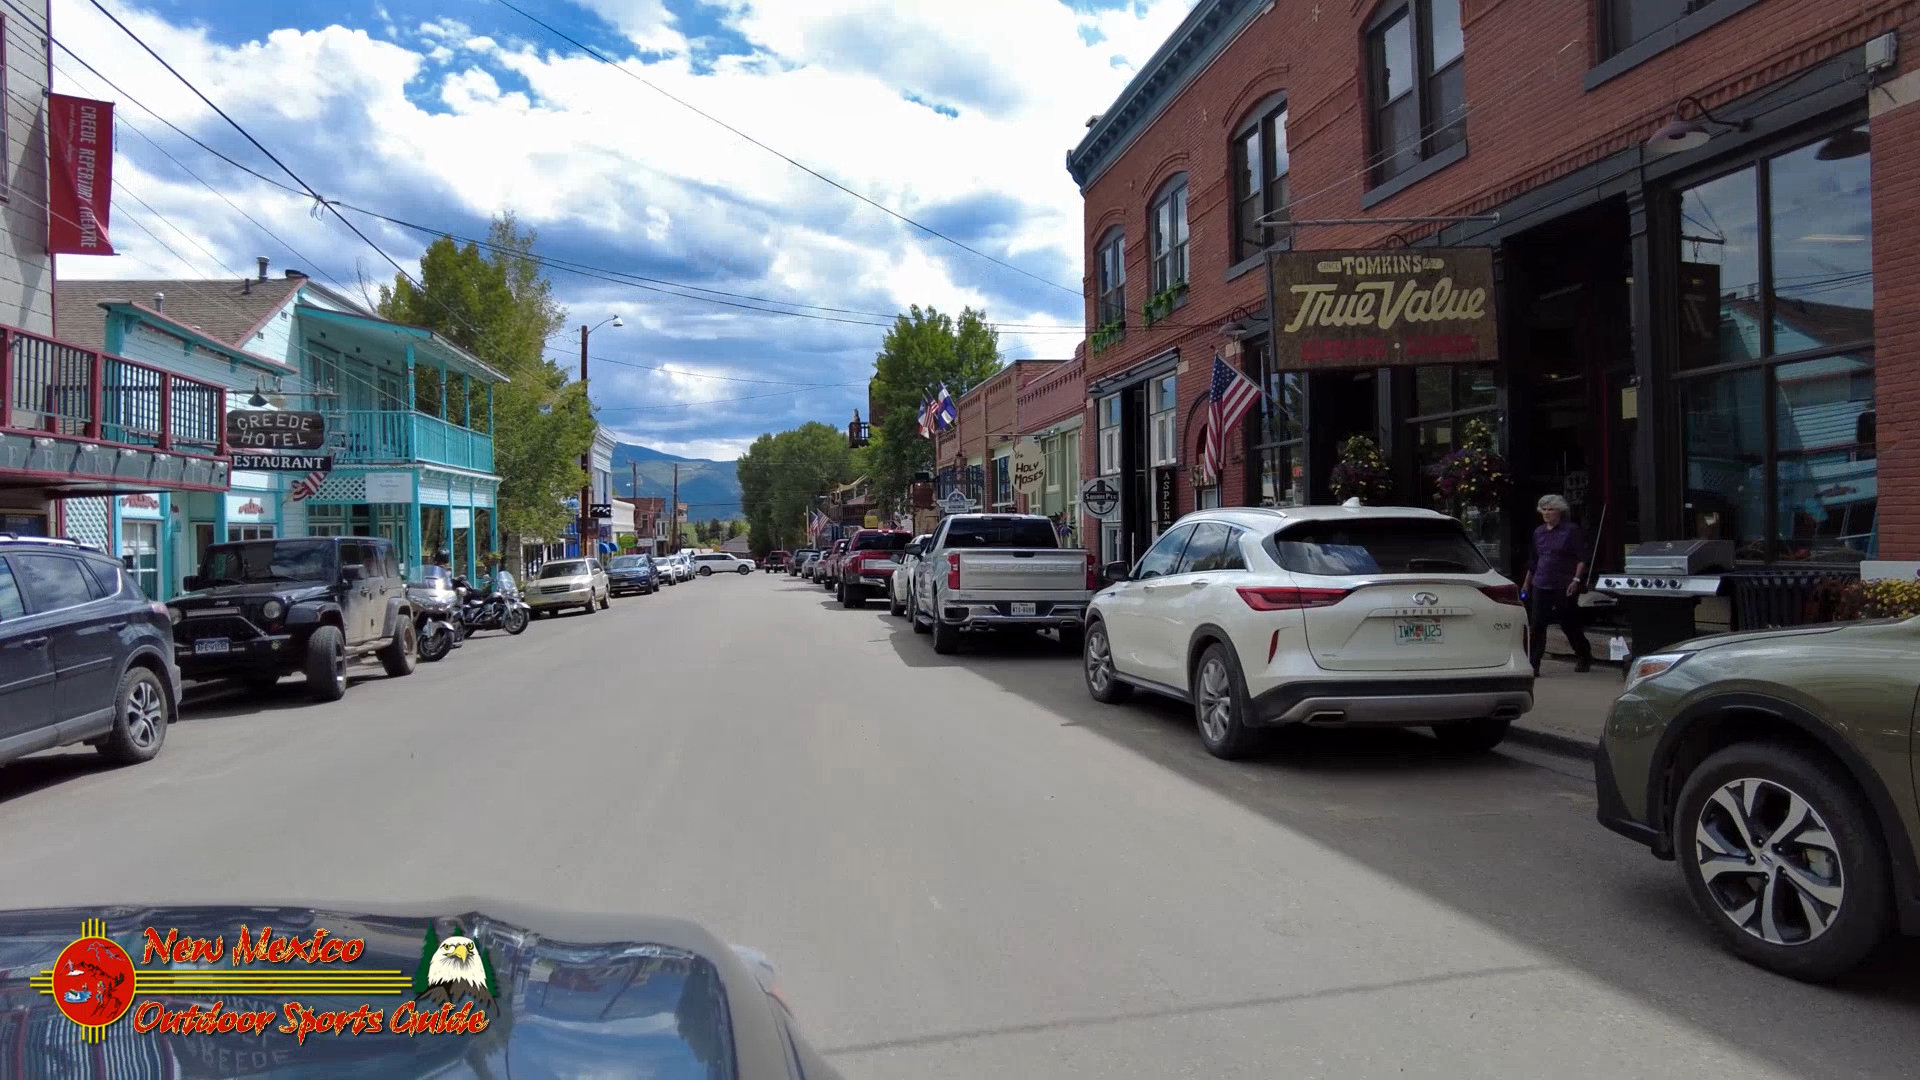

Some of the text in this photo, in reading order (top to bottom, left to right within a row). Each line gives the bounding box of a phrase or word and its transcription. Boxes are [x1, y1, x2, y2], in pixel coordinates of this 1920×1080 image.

[77, 105, 98, 248] CREEDE REPERTORY THEATRE
[1341, 254, 1422, 276] TOMKINS
[1284, 276, 1486, 333] True Value
[236, 413, 312, 431] CREEDE
[241, 430, 307, 447] HOTEL
[232, 456, 325, 469] ESTAURANT
[1016, 461, 1039, 473] HOLY
[1014, 469, 1044, 490] MOSES
[1163, 471, 1171, 520] ASPEN
[1394, 608, 1454, 616] INFINITI
